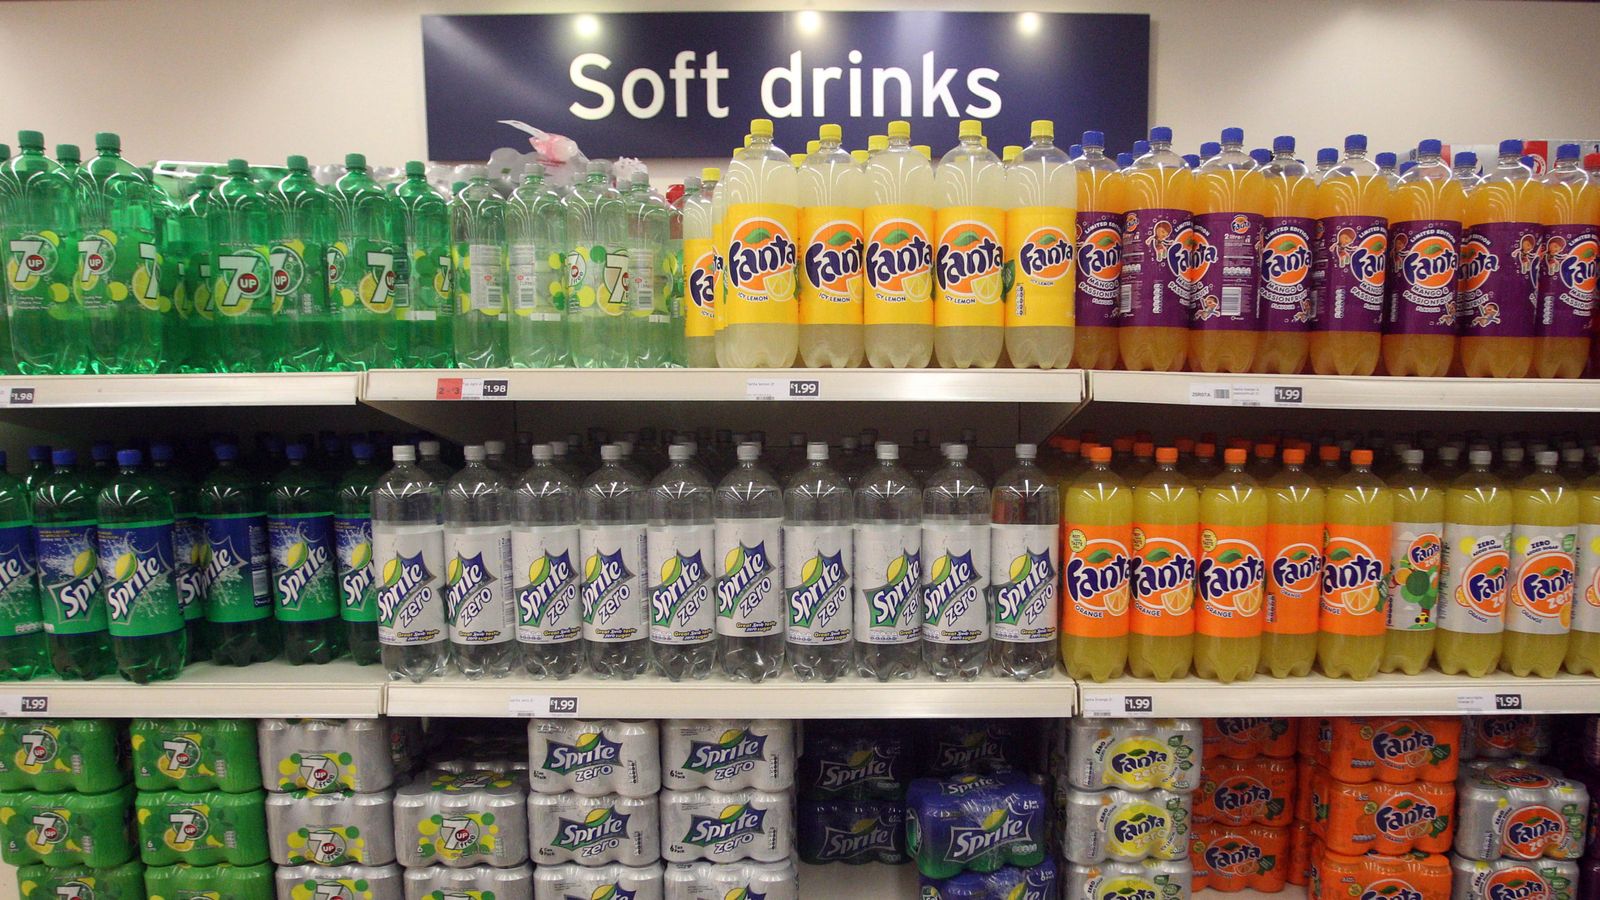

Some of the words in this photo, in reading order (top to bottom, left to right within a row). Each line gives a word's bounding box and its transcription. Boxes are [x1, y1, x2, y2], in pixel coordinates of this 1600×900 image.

[569, 51, 730, 120] Soft
[760, 50, 1003, 120] drinks
[1265, 226, 1288, 240] LIMITED
[1290, 226, 1309, 241] EDITION
[1410, 229, 1435, 242] LIMITED
[1436, 229, 1456, 243] EDITION
[729, 234, 796, 287] Fanta
[805, 239, 864, 288] Fant
[866, 236, 932, 288] Fanta
[937, 238, 1003, 290] Fanta
[1020, 239, 1073, 275] Fanta
[1079, 242, 1121, 276] Fant
[1262, 247, 1312, 282] Fanta
[1352, 248, 1384, 281] Fan
[1404, 249, 1458, 284] Fanta
[1561, 255, 1595, 288] Fan
[1268, 283, 1297, 294] MANGO
[1412, 285, 1442, 296] MANGO
[484, 385, 506, 393] £1.98
[790, 383, 816, 394] £1.99
[1275, 389, 1300, 400] £1.99
[1411, 544, 1440, 563] Fanta
[1477, 540, 1495, 549] ZERO
[1531, 540, 1550, 549] ZERO
[278, 546, 327, 605] Sprite
[343, 560, 374, 606] Spri
[718, 553, 764, 613] Sprite
[1067, 554, 1131, 602] Fanta
[1131, 554, 1195, 599] Fanta
[1200, 555, 1264, 601] Fanta
[1273, 554, 1322, 587] Fanta
[1323, 555, 1382, 594] anta
[1470, 568, 1508, 601] Fant
[1523, 569, 1573, 602] Fanta
[60, 571, 101, 619] Spri
[108, 556, 160, 620] Sprite
[378, 563, 422, 623] Sprite
[448, 564, 483, 621] prite
[519, 561, 569, 622] Sprite
[653, 562, 700, 622] Sprite
[740, 577, 771, 618] zero
[791, 562, 841, 623] Sprite
[924, 562, 972, 621] Sprite
[998, 561, 1049, 623] Sprite
[1280, 589, 1302, 599] ORANGE
[400, 586, 432, 628] zero
[461, 586, 492, 627] zero
[547, 584, 575, 626] zero
[599, 585, 630, 625] zero
[677, 586, 708, 627] zero
[818, 585, 846, 627] zero
[903, 590, 920, 625] zer
[946, 586, 977, 627] zero
[1025, 584, 1053, 626] zero
[1075, 606, 1103, 618] ORANGE
[1135, 603, 1161, 616] ORANGE
[1205, 605, 1232, 618] ORANGE
[550, 700, 575, 710] £1.99
[1125, 698, 1150, 709] £1.99
[1496, 696, 1520, 707] £1.99
[551, 744, 615, 768] Sprite
[691, 738, 758, 768] Sprite
[1112, 750, 1167, 774] Fanta
[1372, 731, 1435, 760] Fanta
[576, 765, 613, 782] zero
[714, 762, 754, 780] zero
[823, 760, 886, 786] Sprite
[948, 776, 994, 795] Sprite
[1214, 784, 1271, 811] Fanta
[560, 813, 622, 846] Sprite
[691, 812, 758, 842] Sprite
[1114, 814, 1165, 843] Fanta
[1376, 803, 1436, 833] Fanta
[1509, 818, 1561, 845] Fanta
[582, 838, 619, 857] zero
[714, 834, 754, 853] zero
[826, 828, 888, 856] Sprite
[953, 817, 1023, 858] Sprite
[1529, 833, 1561, 852] zero
[1205, 845, 1261, 869] Fanta
